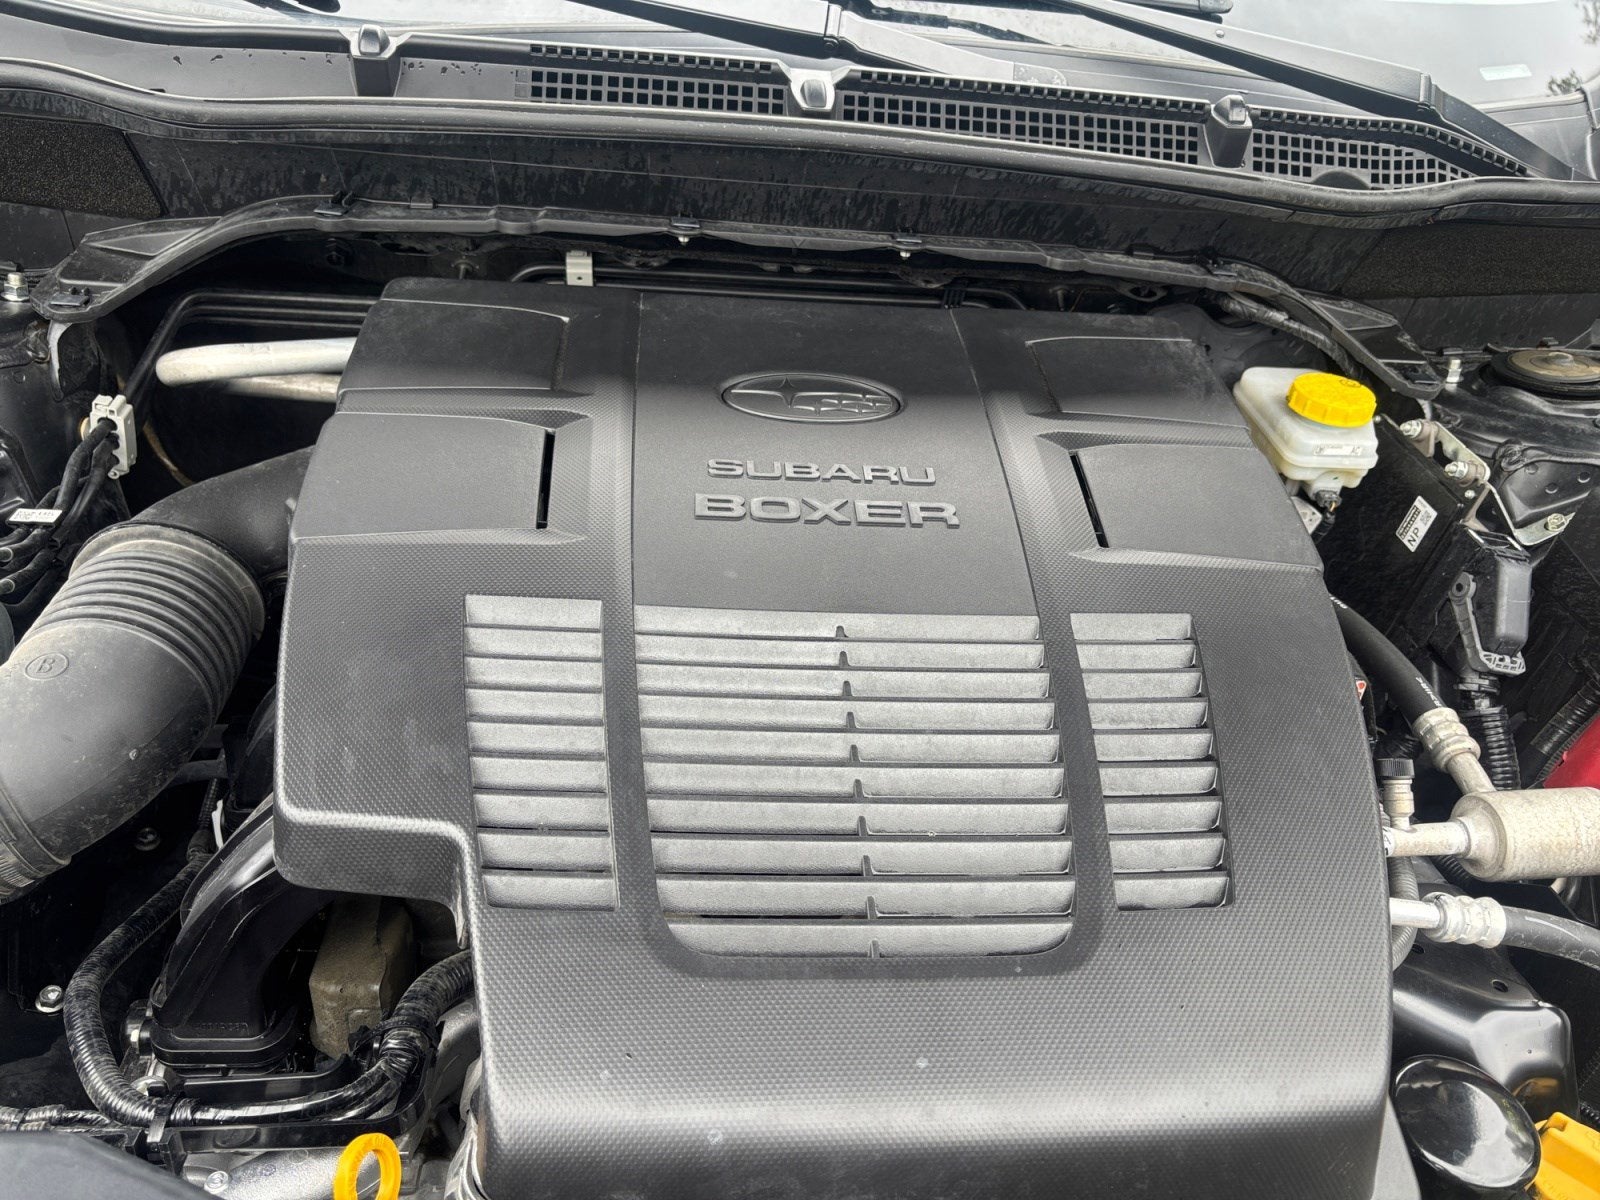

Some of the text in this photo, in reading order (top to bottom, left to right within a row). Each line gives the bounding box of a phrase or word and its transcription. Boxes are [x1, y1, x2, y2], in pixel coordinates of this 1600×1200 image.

[707, 458, 936, 486] SUBARU
[694, 492, 960, 528] BOXER
[1407, 527, 1421, 547] NP
